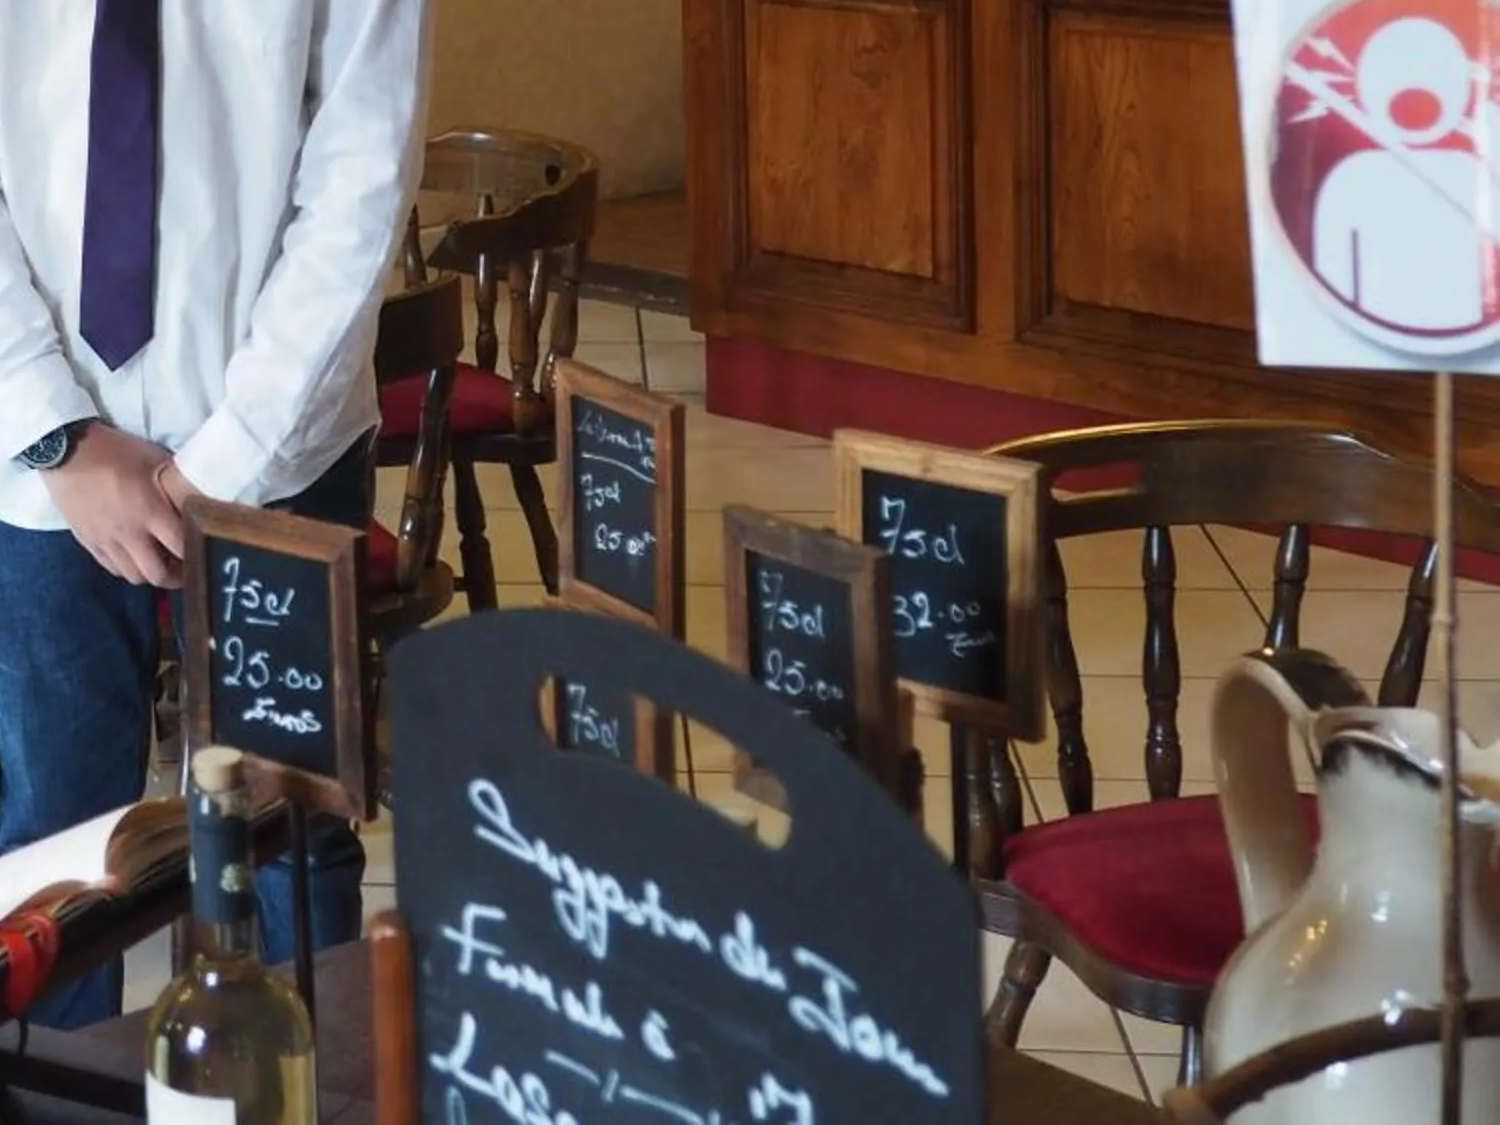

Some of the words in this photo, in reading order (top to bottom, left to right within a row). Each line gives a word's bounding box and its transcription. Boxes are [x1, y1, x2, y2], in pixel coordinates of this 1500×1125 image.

[879, 495, 965, 565] 75cl
[222, 556, 296, 623] 75cl
[760, 571, 826, 639] 75cl
[222, 635, 323, 689] 25.00
[566, 683, 621, 759] 75cl
